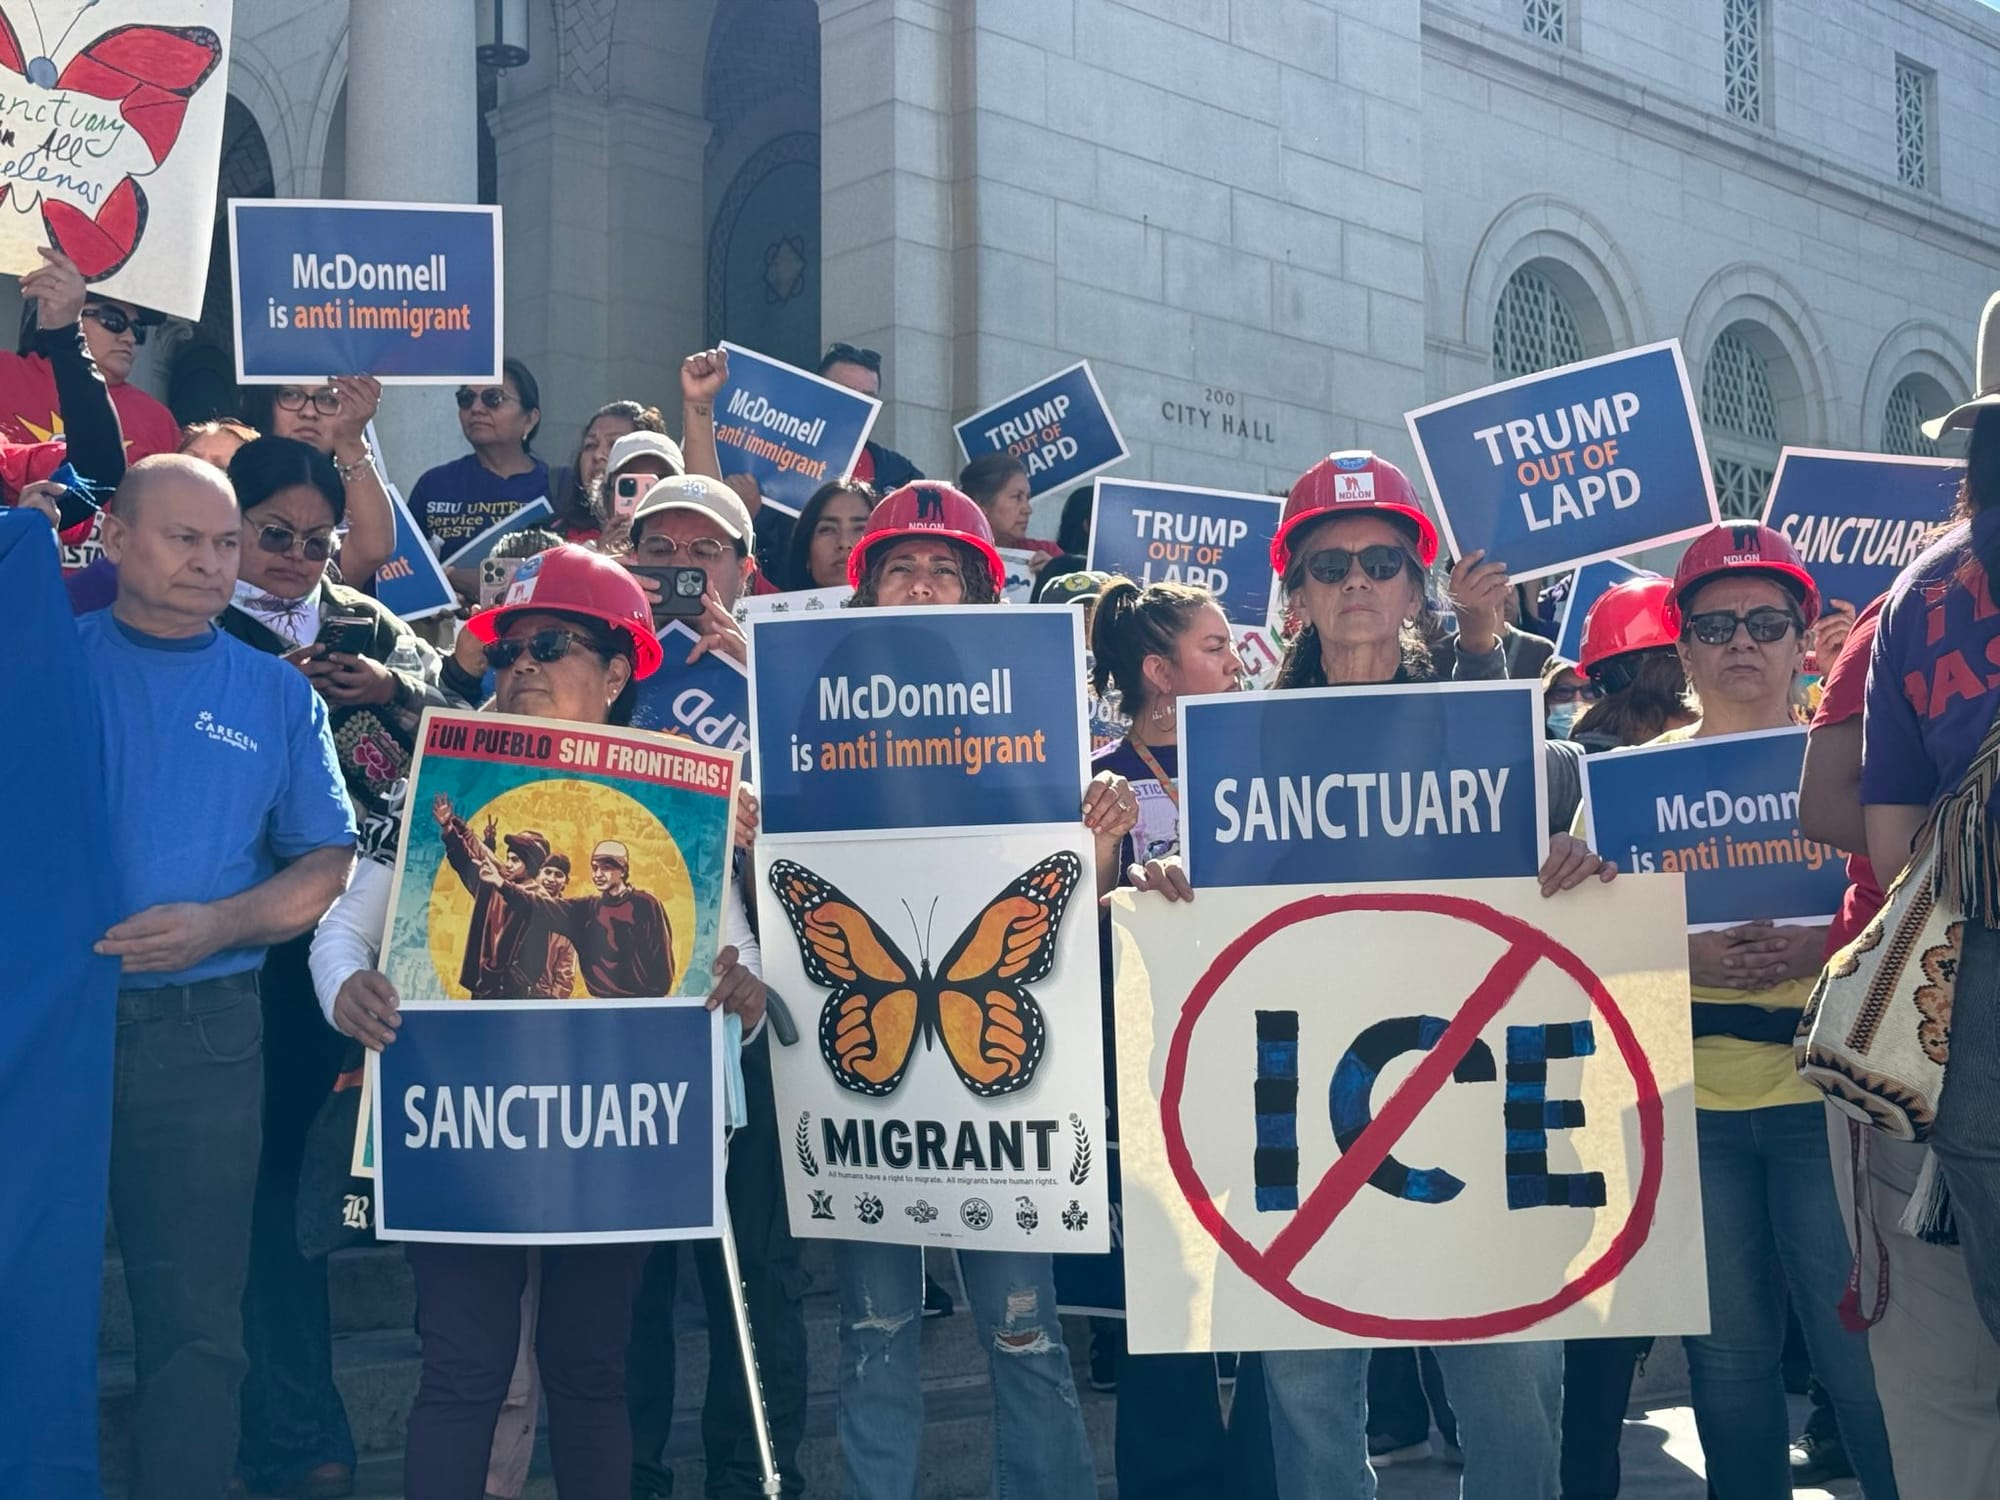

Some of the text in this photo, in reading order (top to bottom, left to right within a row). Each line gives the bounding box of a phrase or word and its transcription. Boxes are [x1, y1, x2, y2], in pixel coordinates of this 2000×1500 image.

[293, 253, 446, 291] McDonnell
[268, 297, 471, 338] is anti immigrant
[727, 388, 826, 447] McDonnell
[1205, 388, 1234, 406] 200
[984, 395, 1070, 450] TRUMP
[1008, 423, 1062, 457] OUT OF
[1162, 401, 1275, 443] CITY HALL
[1473, 392, 1640, 466] TRUMP
[717, 425, 747, 448] anti
[744, 429, 827, 480] immigrant
[1026, 436, 1078, 478] APD
[1517, 440, 1618, 487] OUT OF
[427, 501, 462, 514] SEIU
[1339, 491, 1371, 499] NDLON
[1519, 468, 1641, 532] LAPD
[427, 514, 483, 528] Service
[1132, 509, 1247, 548] TRUMP
[1780, 514, 1944, 566] SANCTUAR
[1149, 542, 1223, 565] OUT OF
[1723, 554, 1760, 565] NDLON
[819, 668, 1012, 721] McDonnell
[194, 721, 258, 752] CARECEN
[429, 724, 729, 790] ¡UN PUEBLO SIN FRONTERAS!
[791, 734, 813, 771] is
[821, 730, 877, 770] anti
[886, 726, 1046, 775] immigrant
[1214, 767, 1509, 843] SANCTUARY
[1656, 790, 1800, 833] McDonn
[1630, 845, 1655, 873] is
[1662, 836, 1719, 872] anti
[404, 1081, 689, 1150] SANCTUARY
[1255, 1010, 1607, 1213] ICE
[821, 1117, 1059, 1171] MIGRANT
[865, 1172, 880, 1180] have
[888, 1174, 904, 1182] right
[957, 1176, 989, 1185] migrants
[990, 1177, 1007, 1185] have
[1009, 1177, 1033, 1185] human
